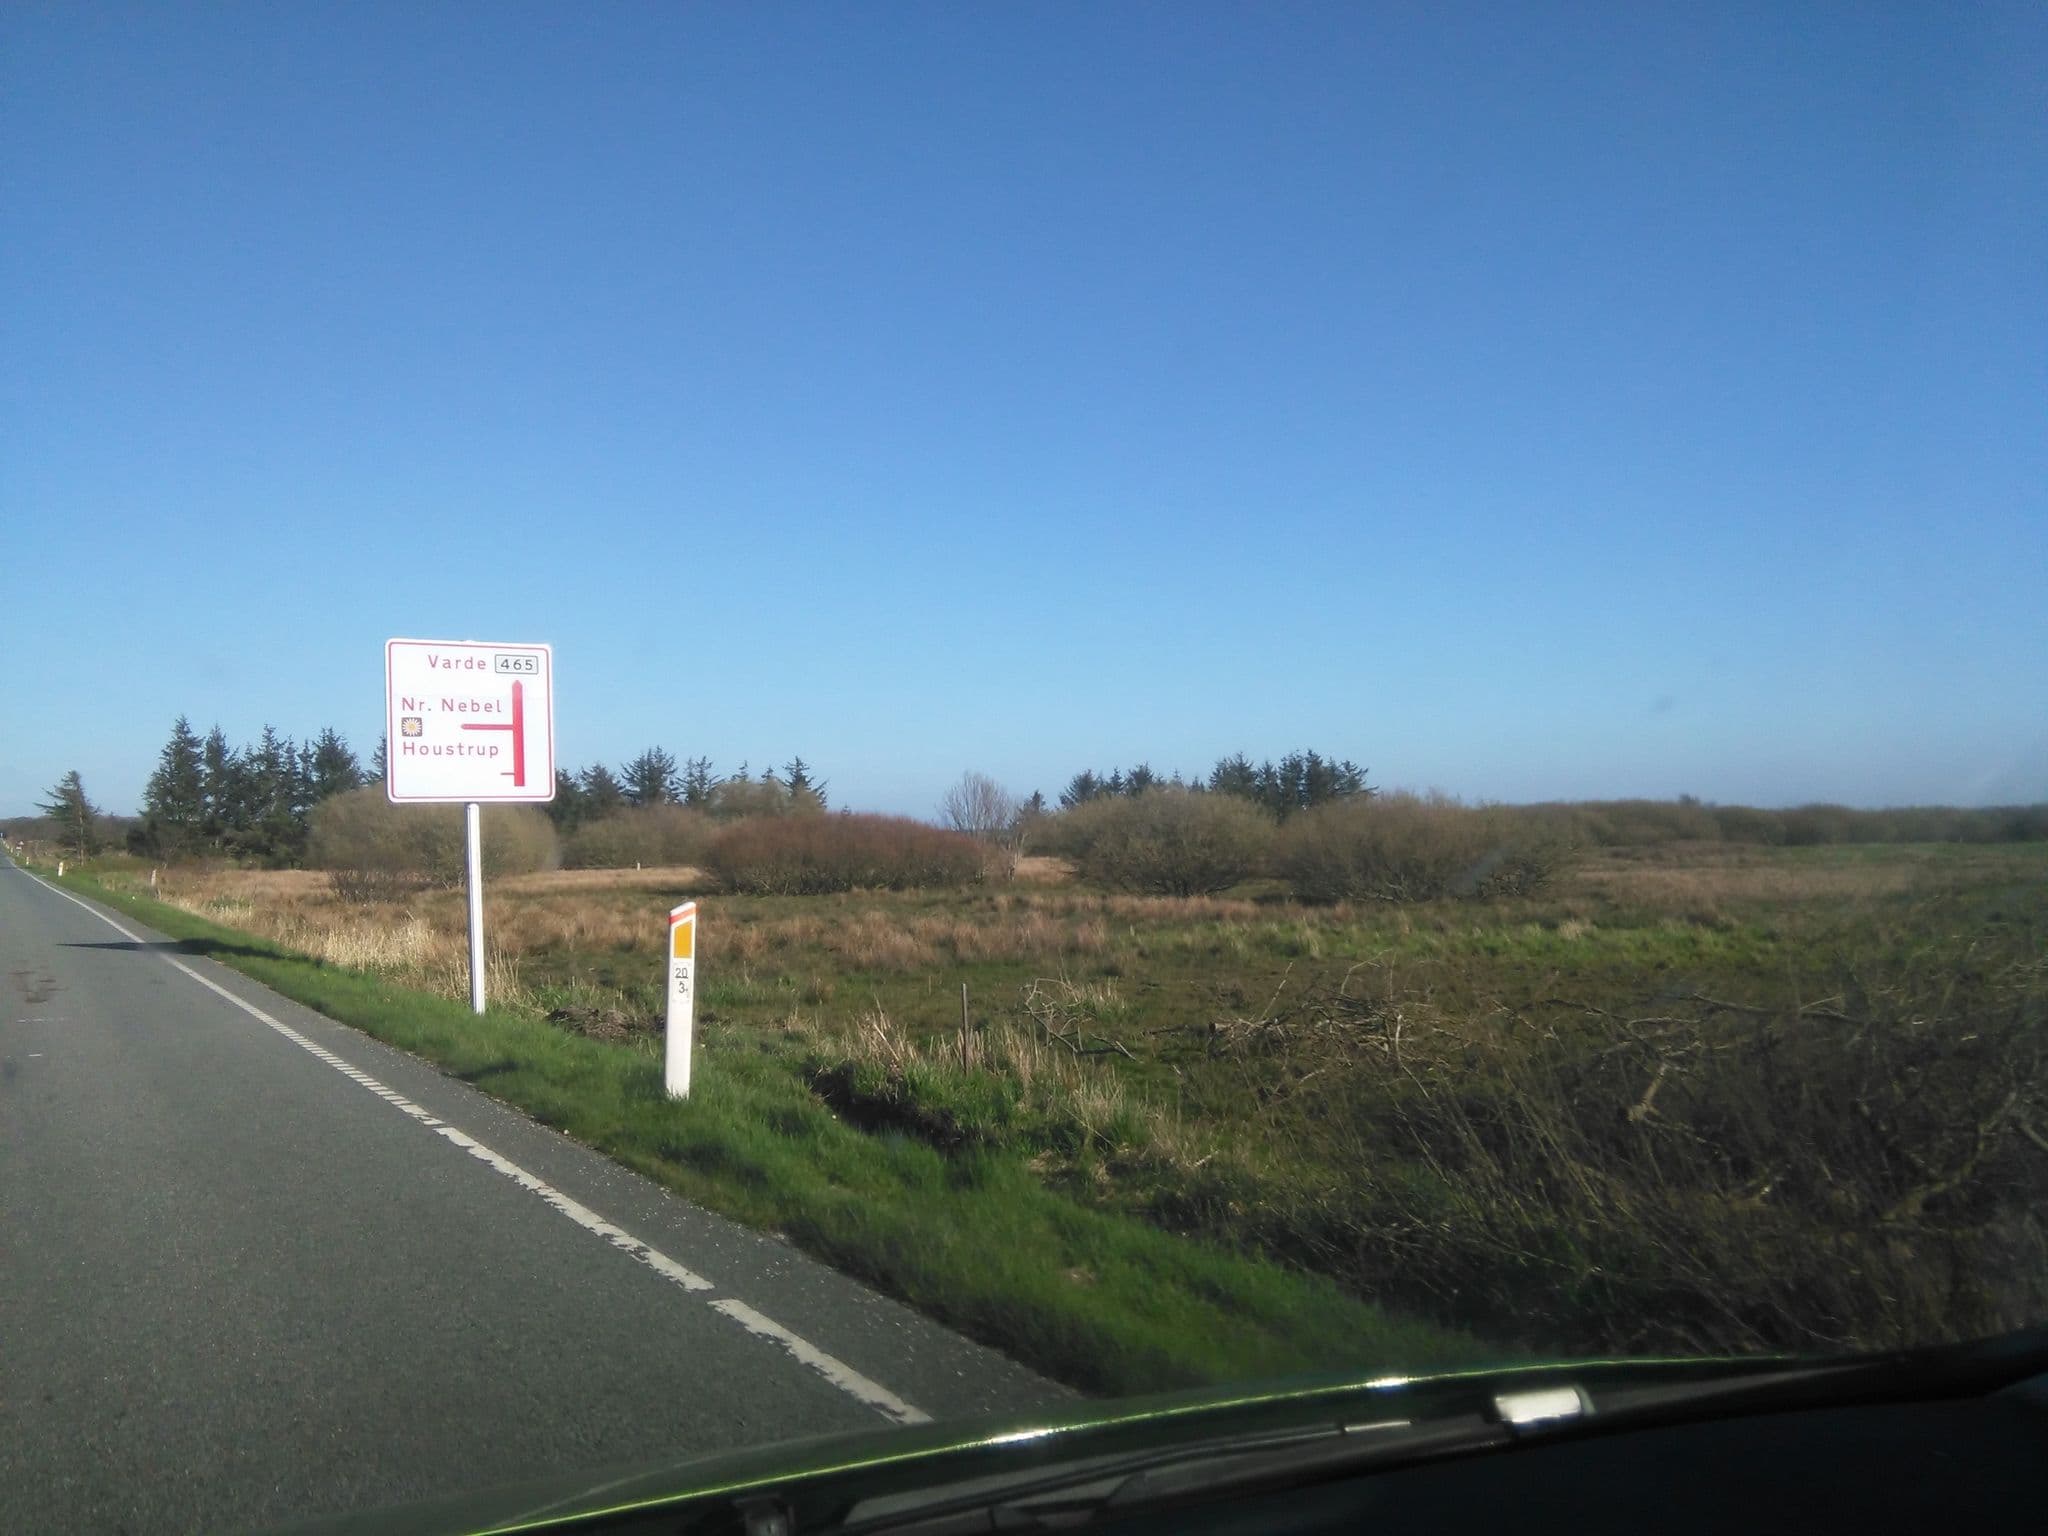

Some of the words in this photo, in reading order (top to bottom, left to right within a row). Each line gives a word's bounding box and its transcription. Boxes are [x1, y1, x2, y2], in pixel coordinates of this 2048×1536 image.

[428, 655, 487, 670] Varde
[500, 658, 533, 671] 465
[402, 697, 431, 712] Nr.
[441, 698, 502, 713] Nebel
[402, 741, 499, 758] Houstrup
[675, 967, 688, 978] 20
